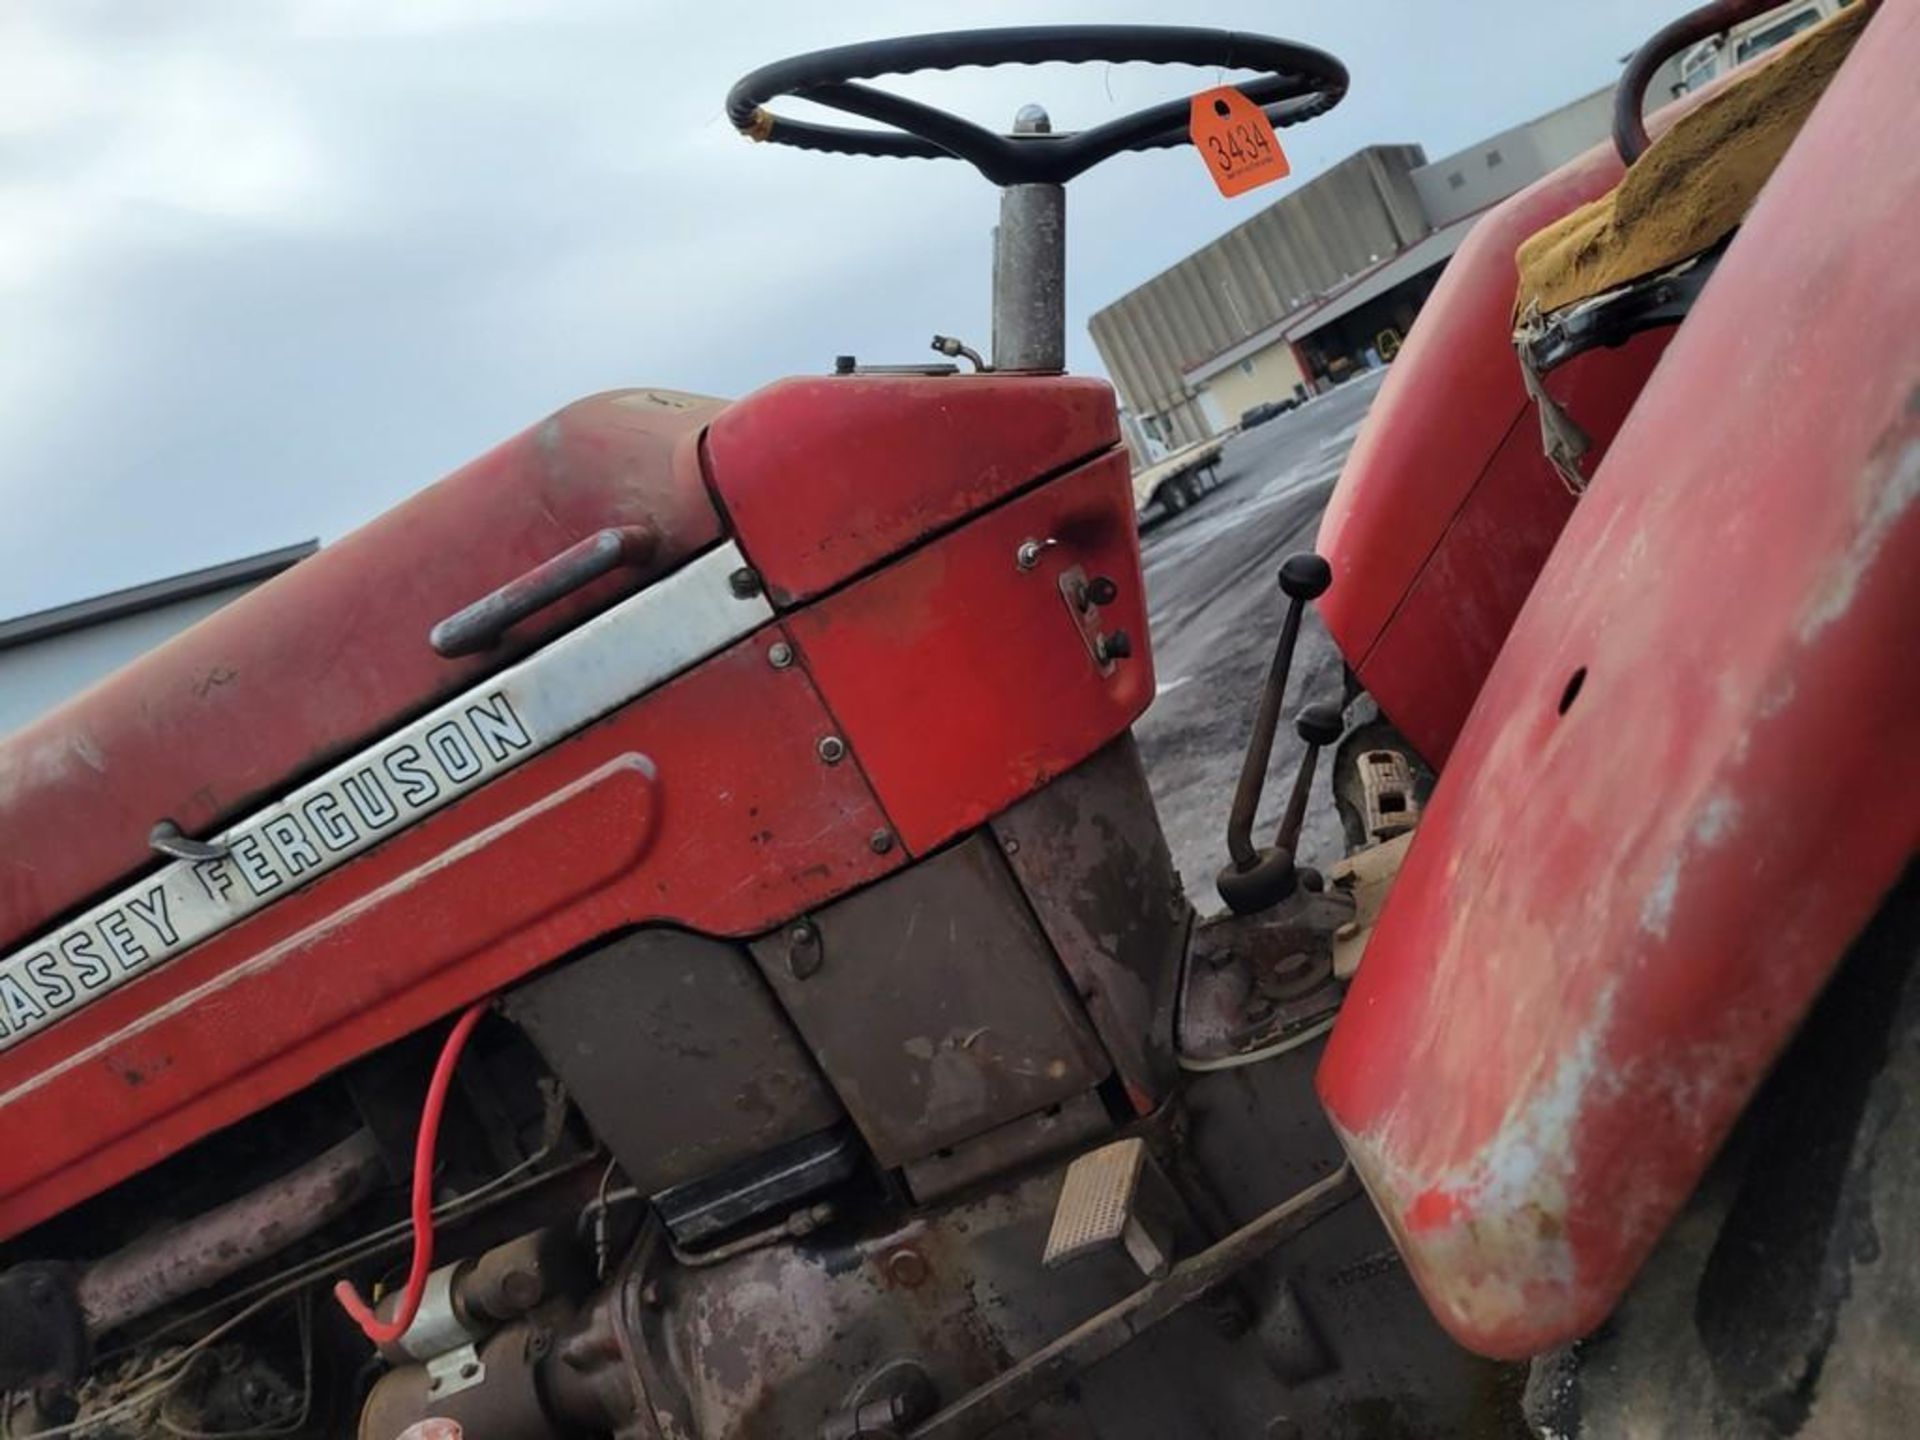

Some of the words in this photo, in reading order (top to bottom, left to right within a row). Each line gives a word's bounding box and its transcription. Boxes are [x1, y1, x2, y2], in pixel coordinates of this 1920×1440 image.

[1208, 121, 1271, 171] 3434
[0, 886, 180, 1038] ASSEY
[192, 691, 532, 901] FERGUSON
